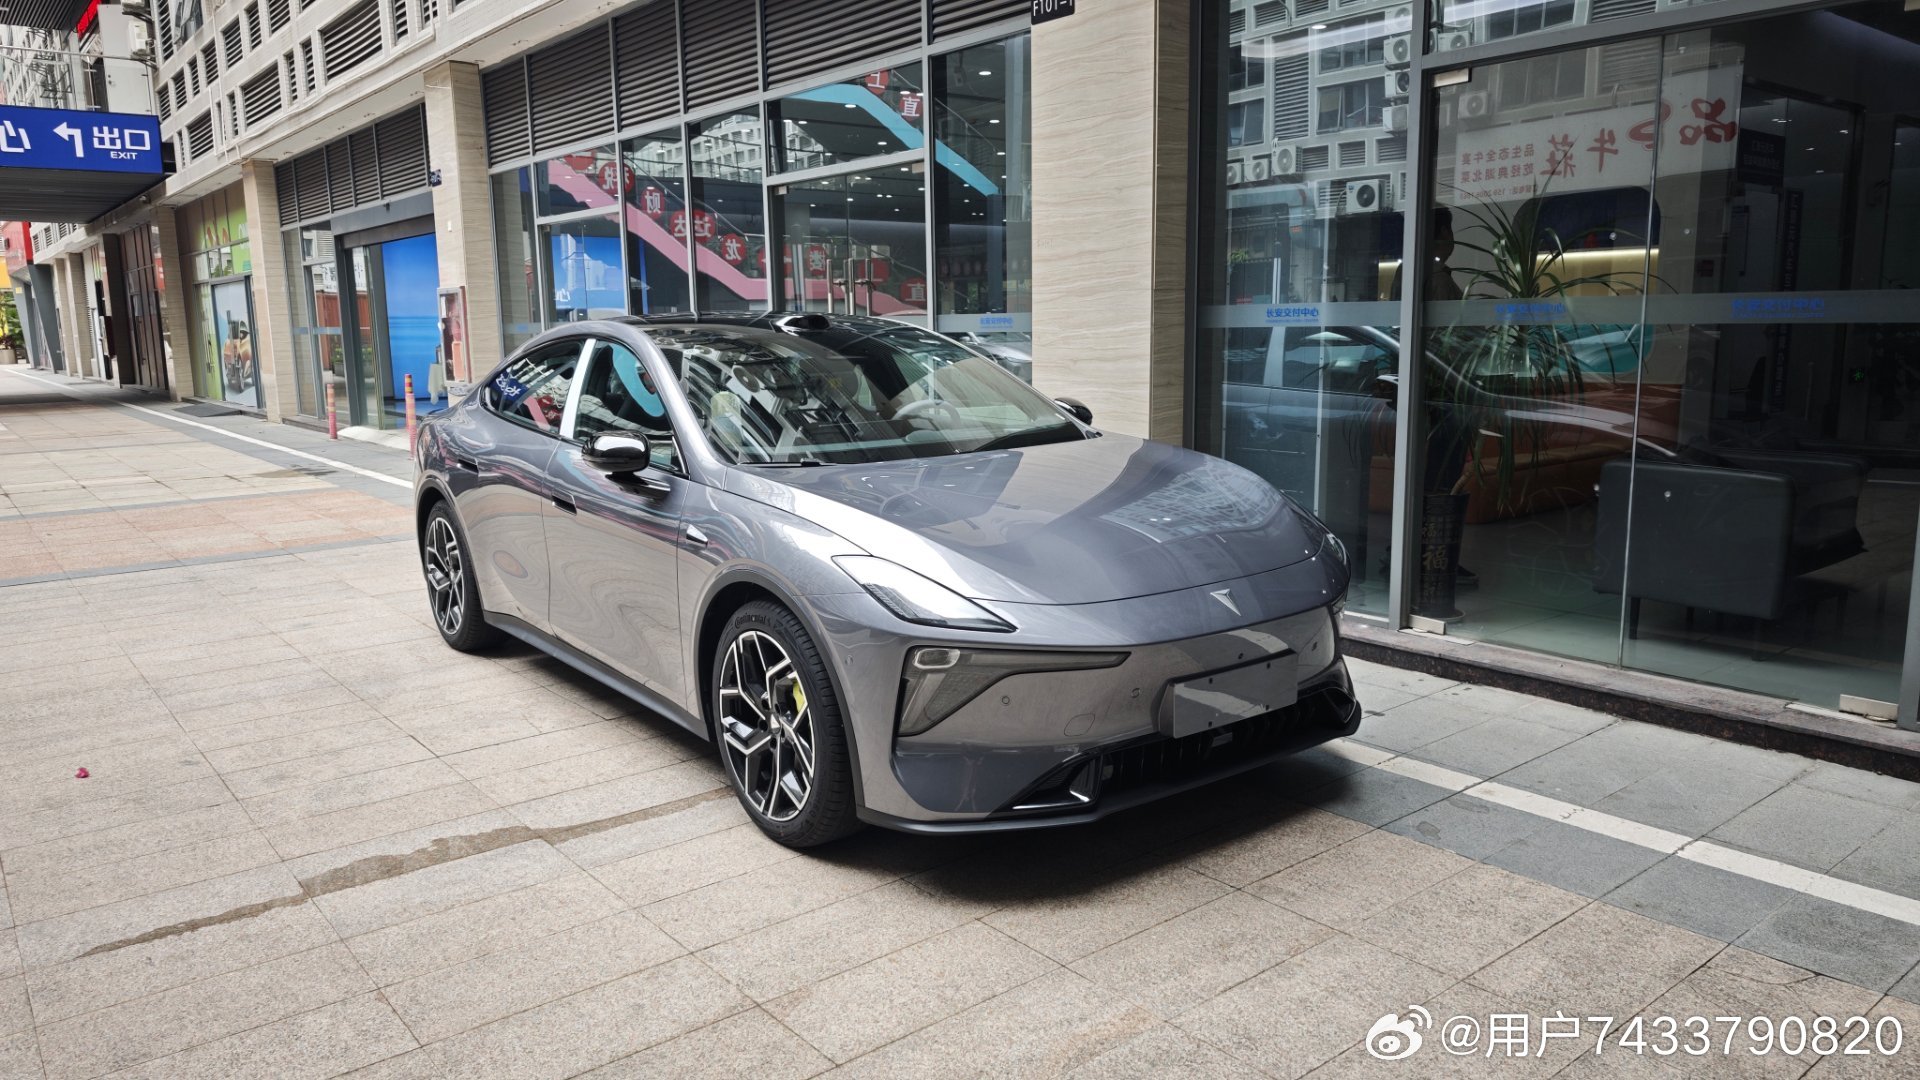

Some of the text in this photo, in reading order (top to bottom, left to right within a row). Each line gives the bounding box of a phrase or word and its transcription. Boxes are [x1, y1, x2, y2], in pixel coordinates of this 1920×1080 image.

[92, 126, 151, 151] 出口
[110, 151, 138, 160] EXIT
[1266, 307, 1319, 318] 长安交付中心
[1422, 544, 1449, 571] 福
